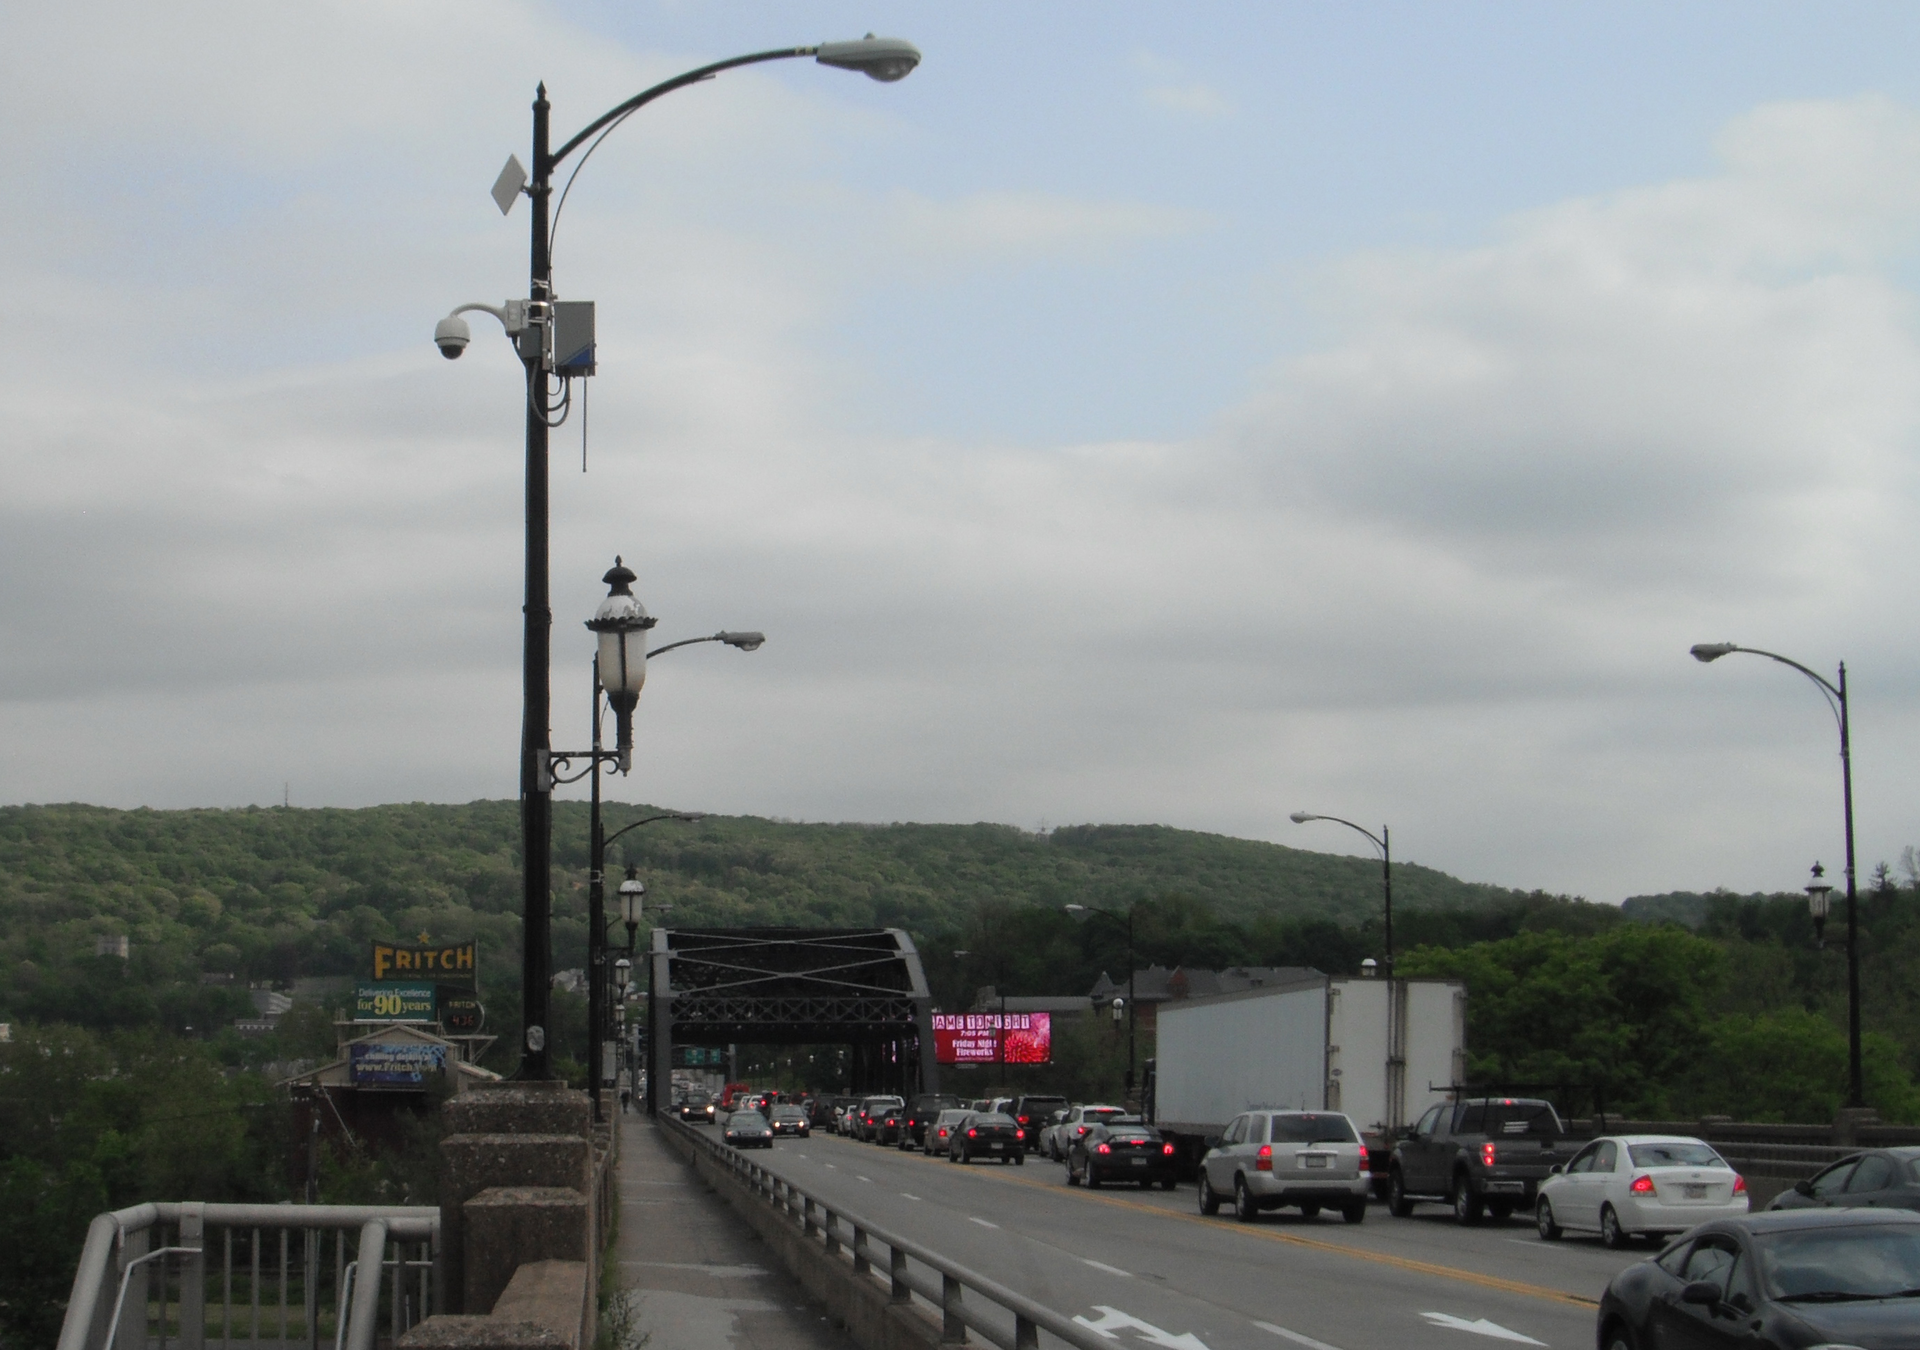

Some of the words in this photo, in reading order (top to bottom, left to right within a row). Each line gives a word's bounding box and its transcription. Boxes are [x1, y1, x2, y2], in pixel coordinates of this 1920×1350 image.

[375, 945, 473, 979] FRITCH
[394, 988, 431, 998] Excellence
[357, 998, 373, 1010] for
[373, 994, 402, 1015] 90
[402, 1001, 432, 1014] years
[966, 1014, 1030, 1030] TONIGHT
[952, 1039, 976, 1048] Friday
[956, 1048, 994, 1057] Fireworks
